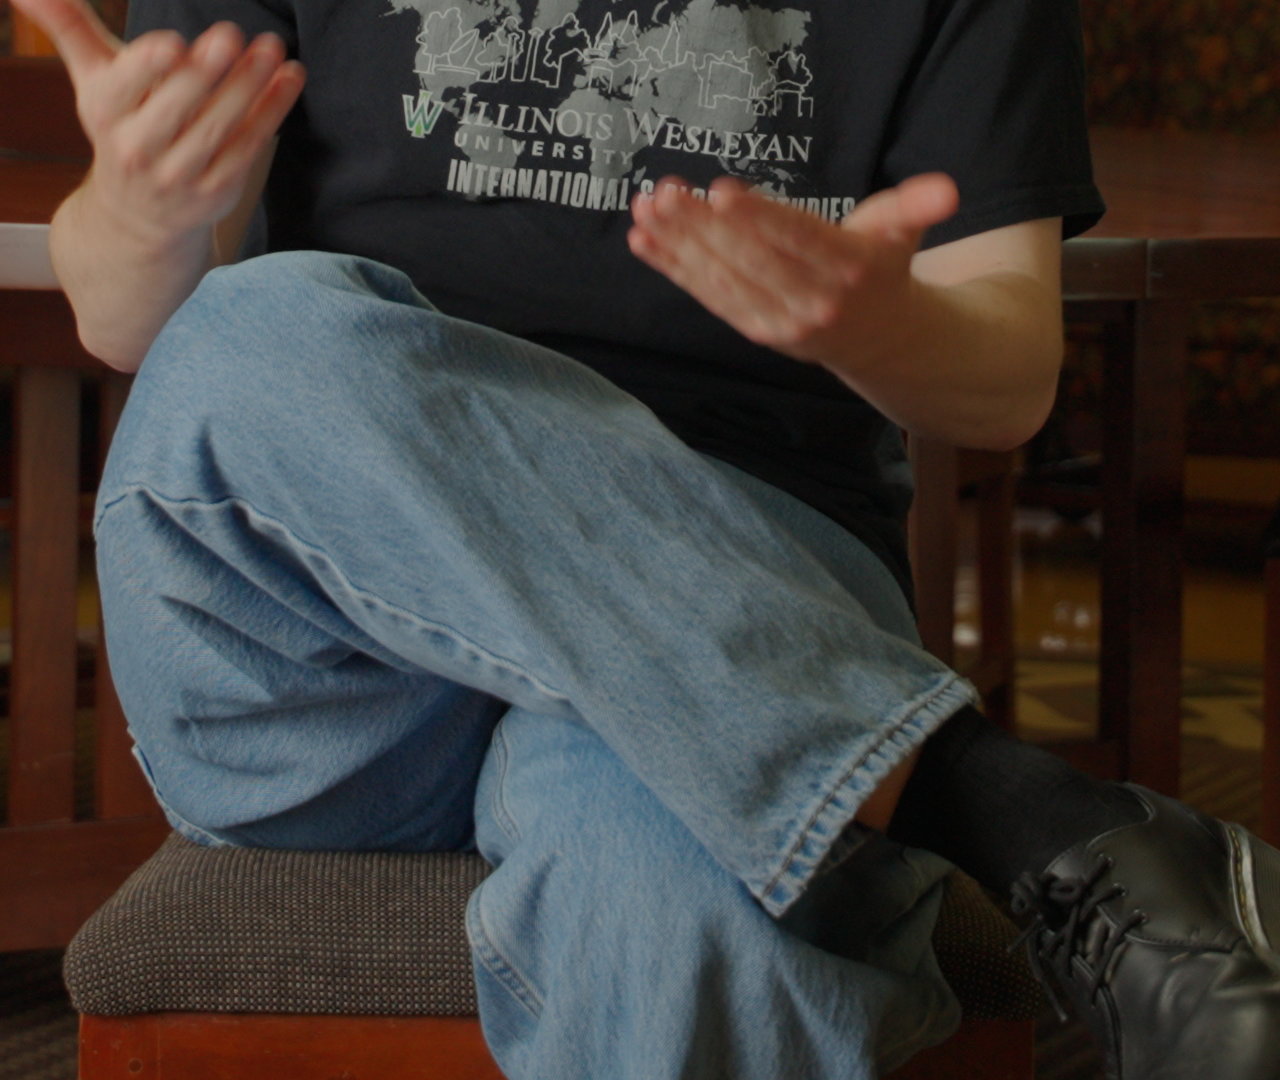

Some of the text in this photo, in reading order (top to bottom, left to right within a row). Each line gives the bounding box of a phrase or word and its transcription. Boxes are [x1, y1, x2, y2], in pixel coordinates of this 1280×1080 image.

[454, 131, 634, 165] UNIVERSITY
[457, 92, 813, 163] ILLINOIS WESLEYAN
[446, 158, 629, 211] INTERNATIONAL
